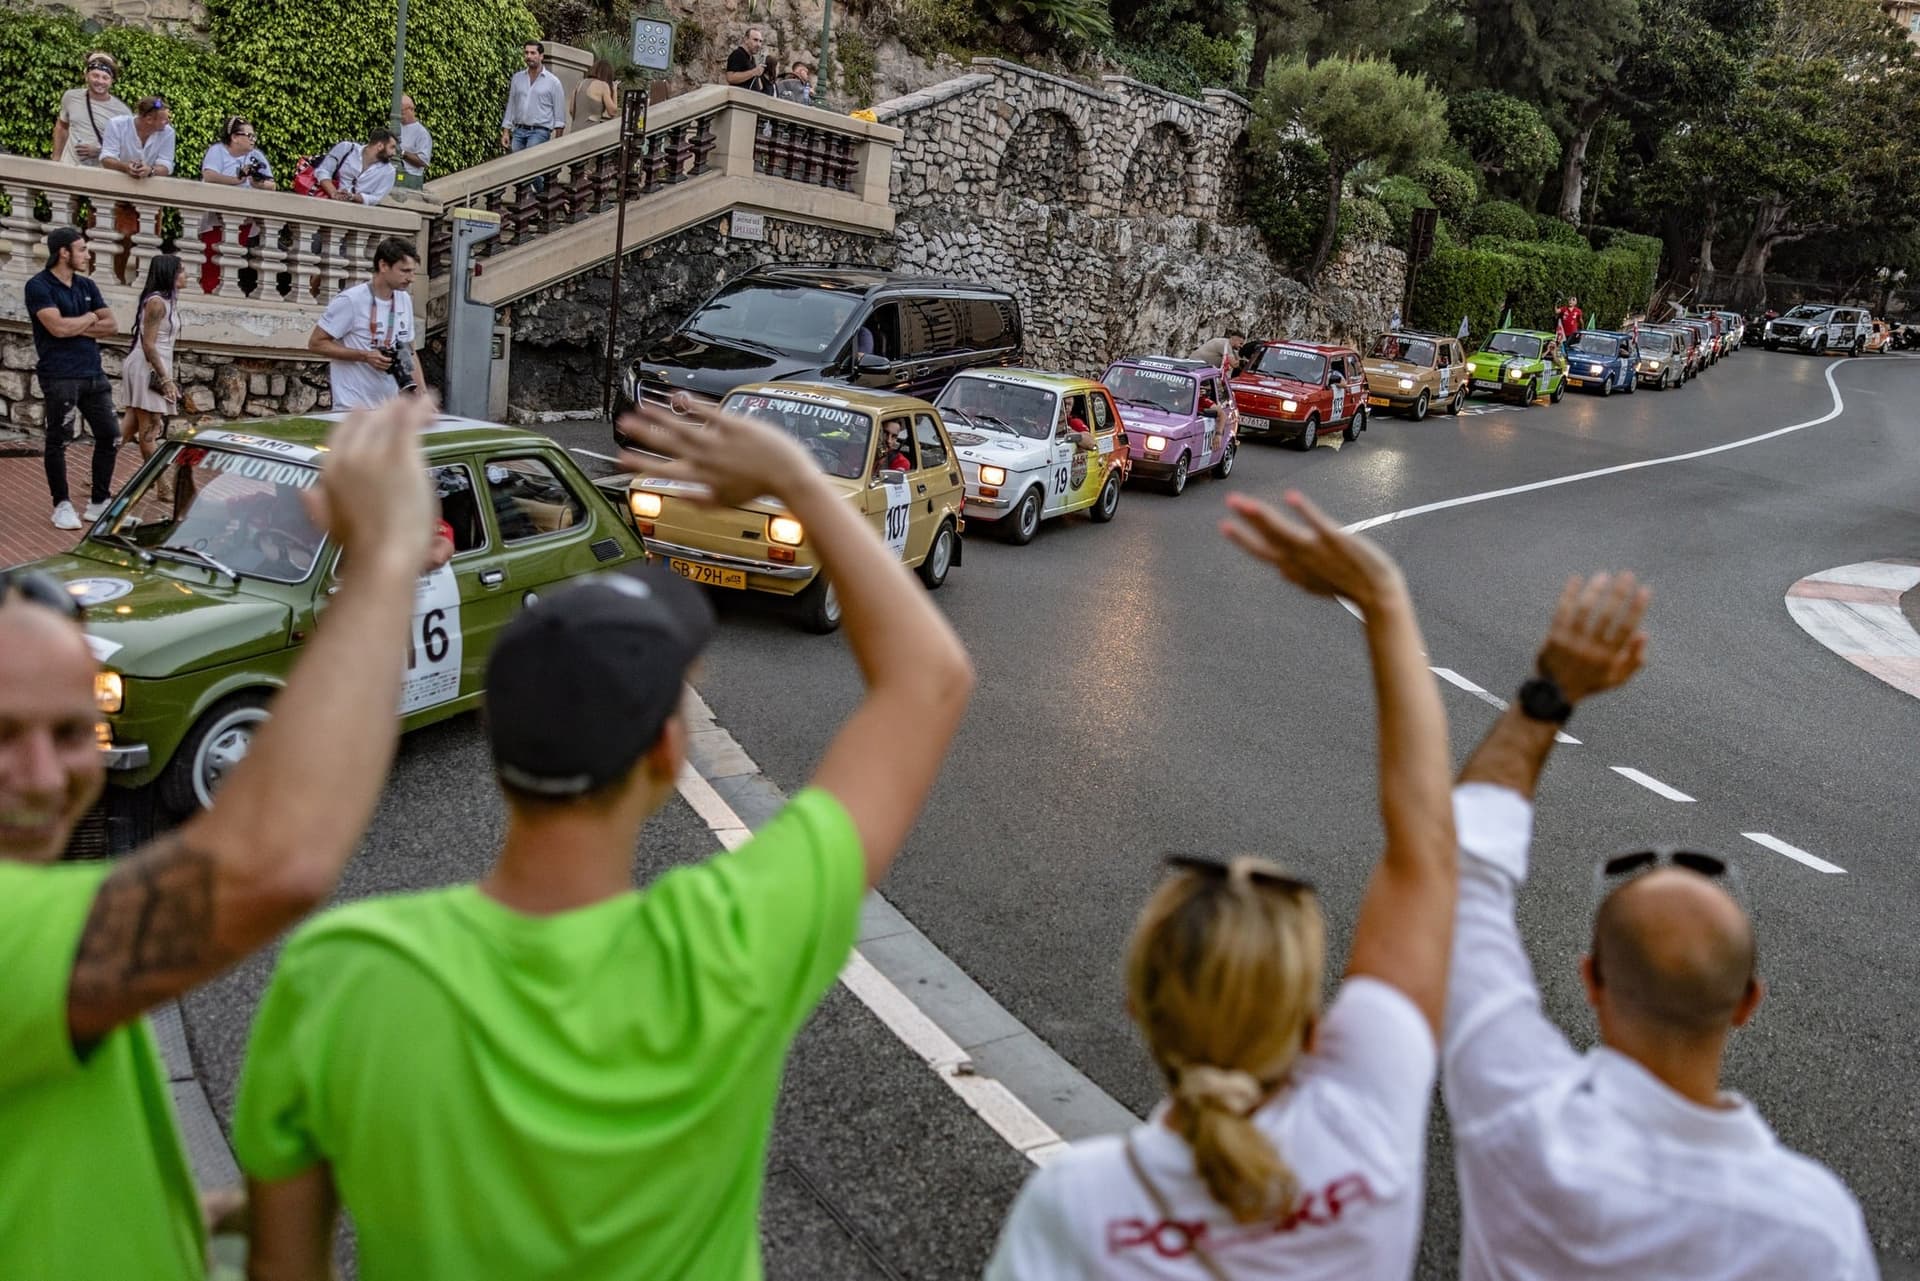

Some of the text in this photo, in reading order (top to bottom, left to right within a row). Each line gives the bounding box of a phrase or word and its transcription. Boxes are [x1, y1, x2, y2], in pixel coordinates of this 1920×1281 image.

[986, 373, 1028, 383] POLAND
[773, 388, 831, 401] POLAND
[1055, 466, 1068, 495] 19
[887, 503, 909, 541] 107
[671, 560, 722, 585] SB 79H
